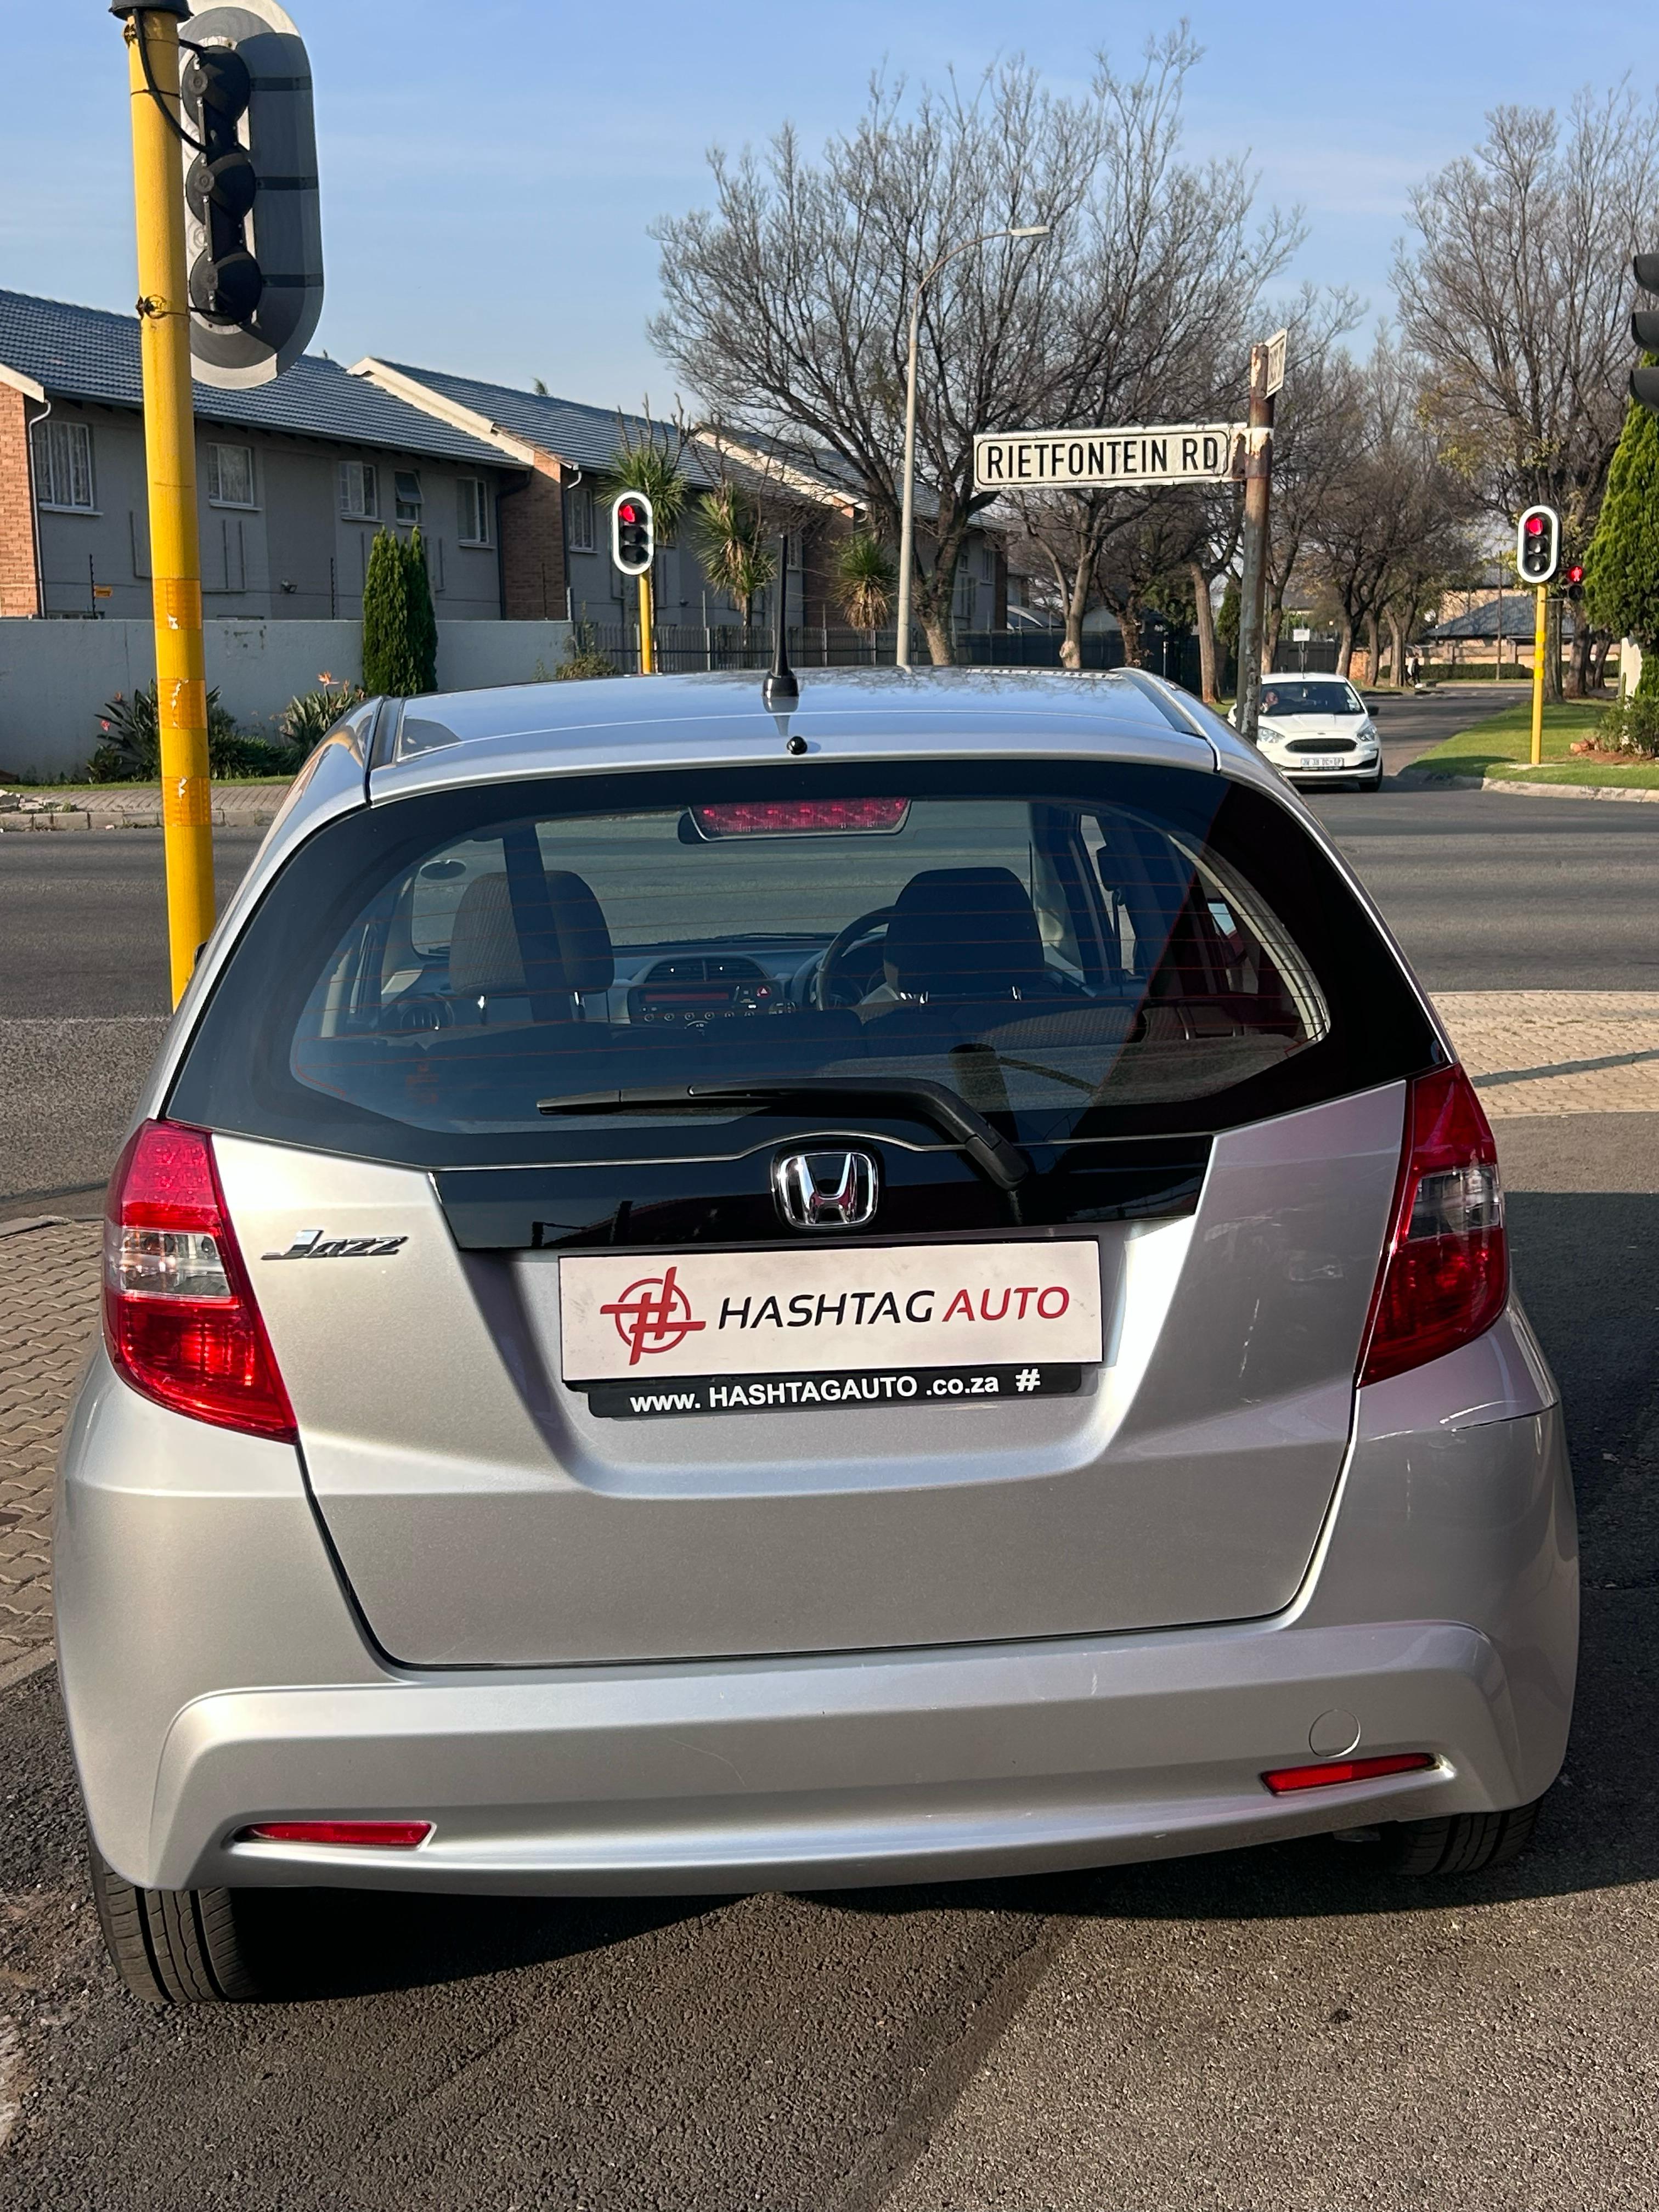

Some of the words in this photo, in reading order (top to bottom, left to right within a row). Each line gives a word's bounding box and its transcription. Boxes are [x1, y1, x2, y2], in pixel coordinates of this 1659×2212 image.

[988, 439, 1167, 479] RIETFONTEIN
[1182, 437, 1218, 471] RD
[260, 1229, 410, 1260] Jazz
[718, 1290, 935, 1329] HASHTAG
[941, 1286, 1070, 1322] AUTO
[630, 1393, 701, 1413] www.
[709, 1375, 918, 1408] HASHTAGAUTO
[926, 1375, 1000, 1396] .co.za
